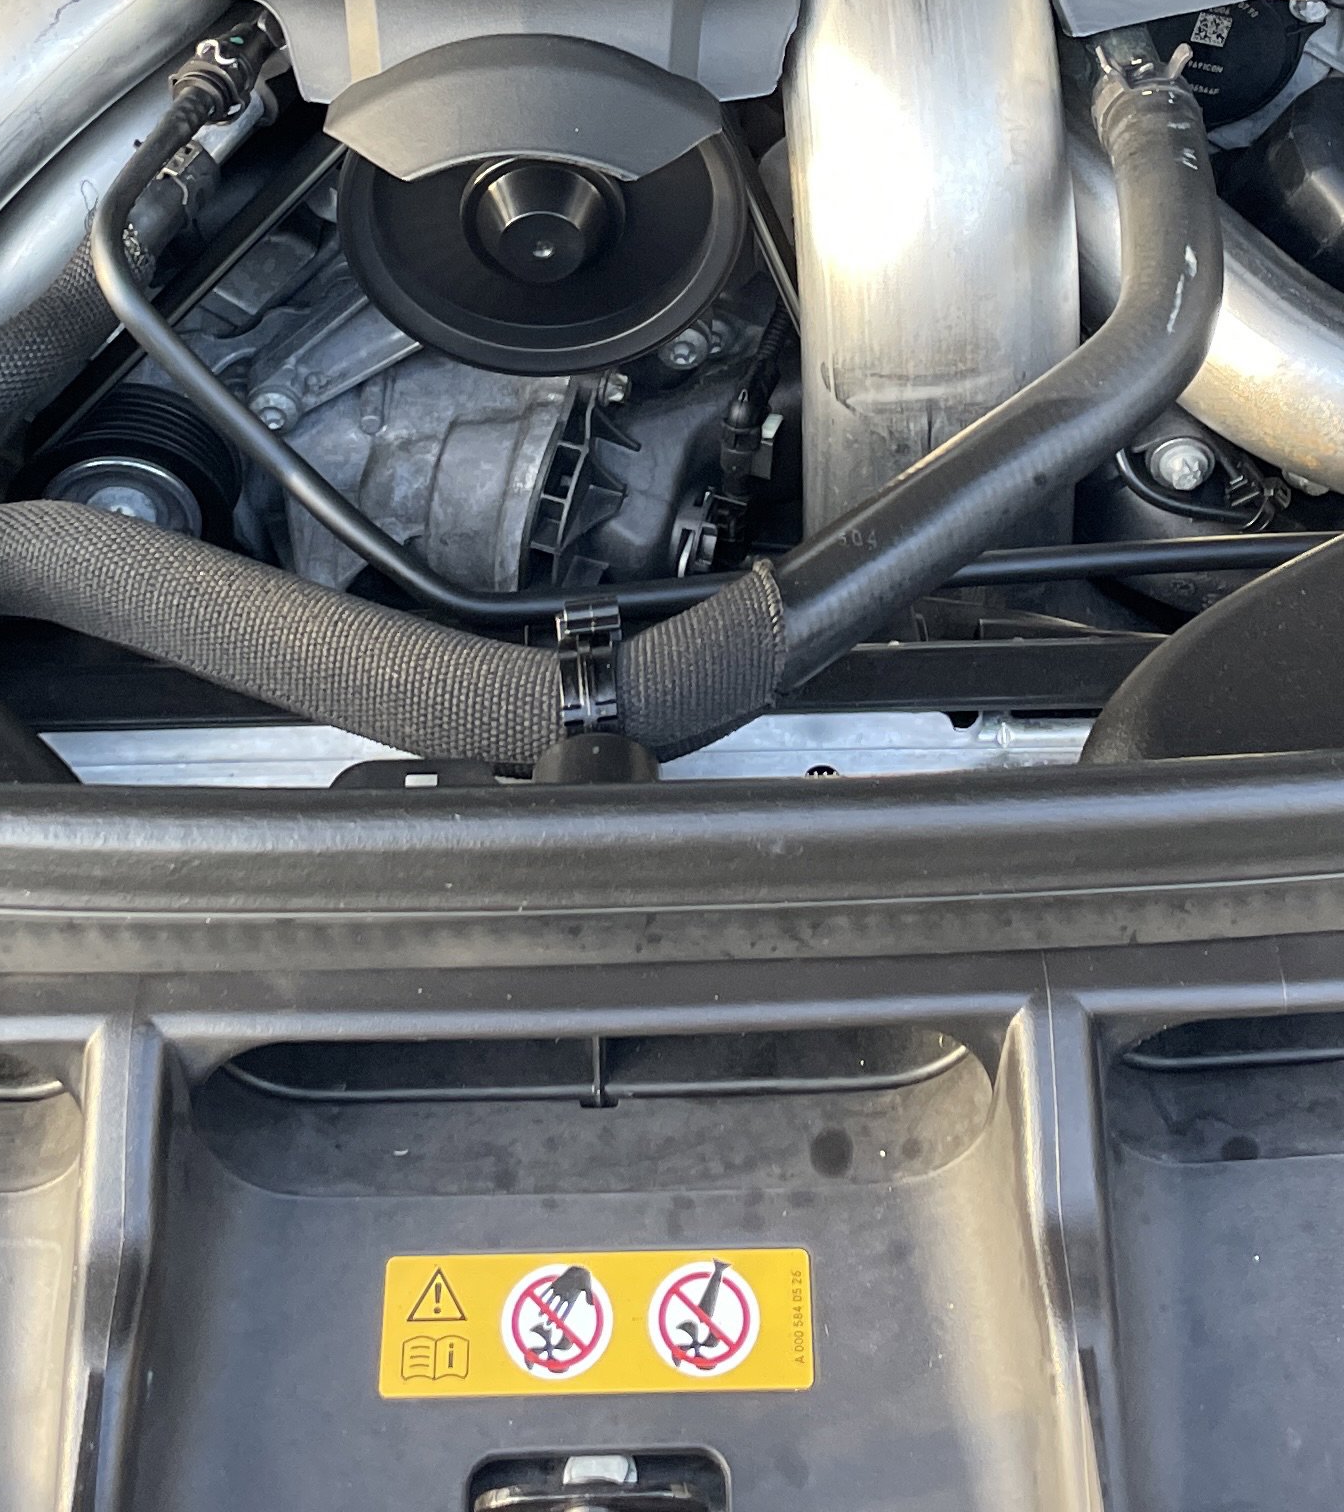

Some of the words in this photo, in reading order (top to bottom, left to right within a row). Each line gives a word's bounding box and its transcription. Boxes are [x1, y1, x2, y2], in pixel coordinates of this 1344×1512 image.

[792, 1305, 803, 1327] 584
[794, 1330, 804, 1352] 000
[794, 1355, 805, 1364] A
